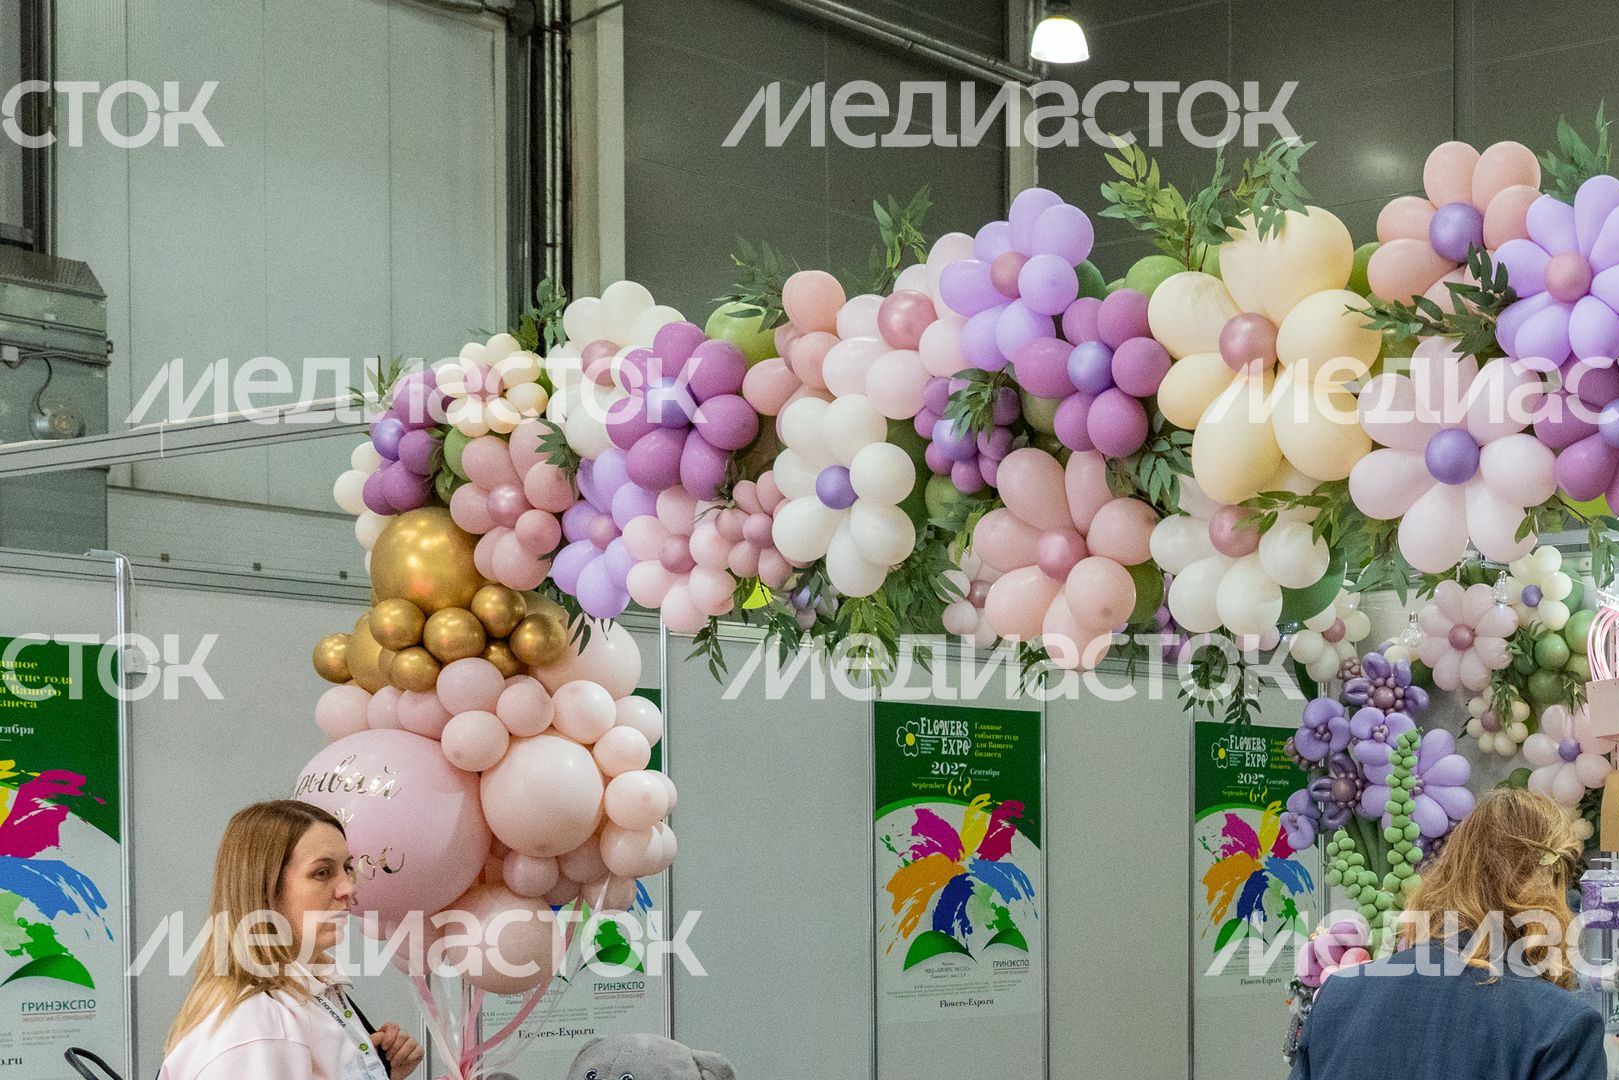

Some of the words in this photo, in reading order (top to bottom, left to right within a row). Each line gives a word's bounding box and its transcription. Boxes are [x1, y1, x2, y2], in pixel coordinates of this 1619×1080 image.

[919, 716, 969, 737] FLOWERS
[941, 737, 971, 756] EXPO
[1229, 735, 1267, 752] FLOWERS
[1245, 752, 1269, 768] EXPO
[931, 761, 967, 782] 2027
[911, 781, 945, 791] September
[1237, 772, 1265, 790] 2027
[992, 959, 1030, 969] ГРИНЭКСПО
[593, 981, 645, 991] ГРИНЭКСПО
[21, 999, 96, 1012] ГРИНЭКСПО
[939, 998, 994, 1009] Flowers-Expo.ru
